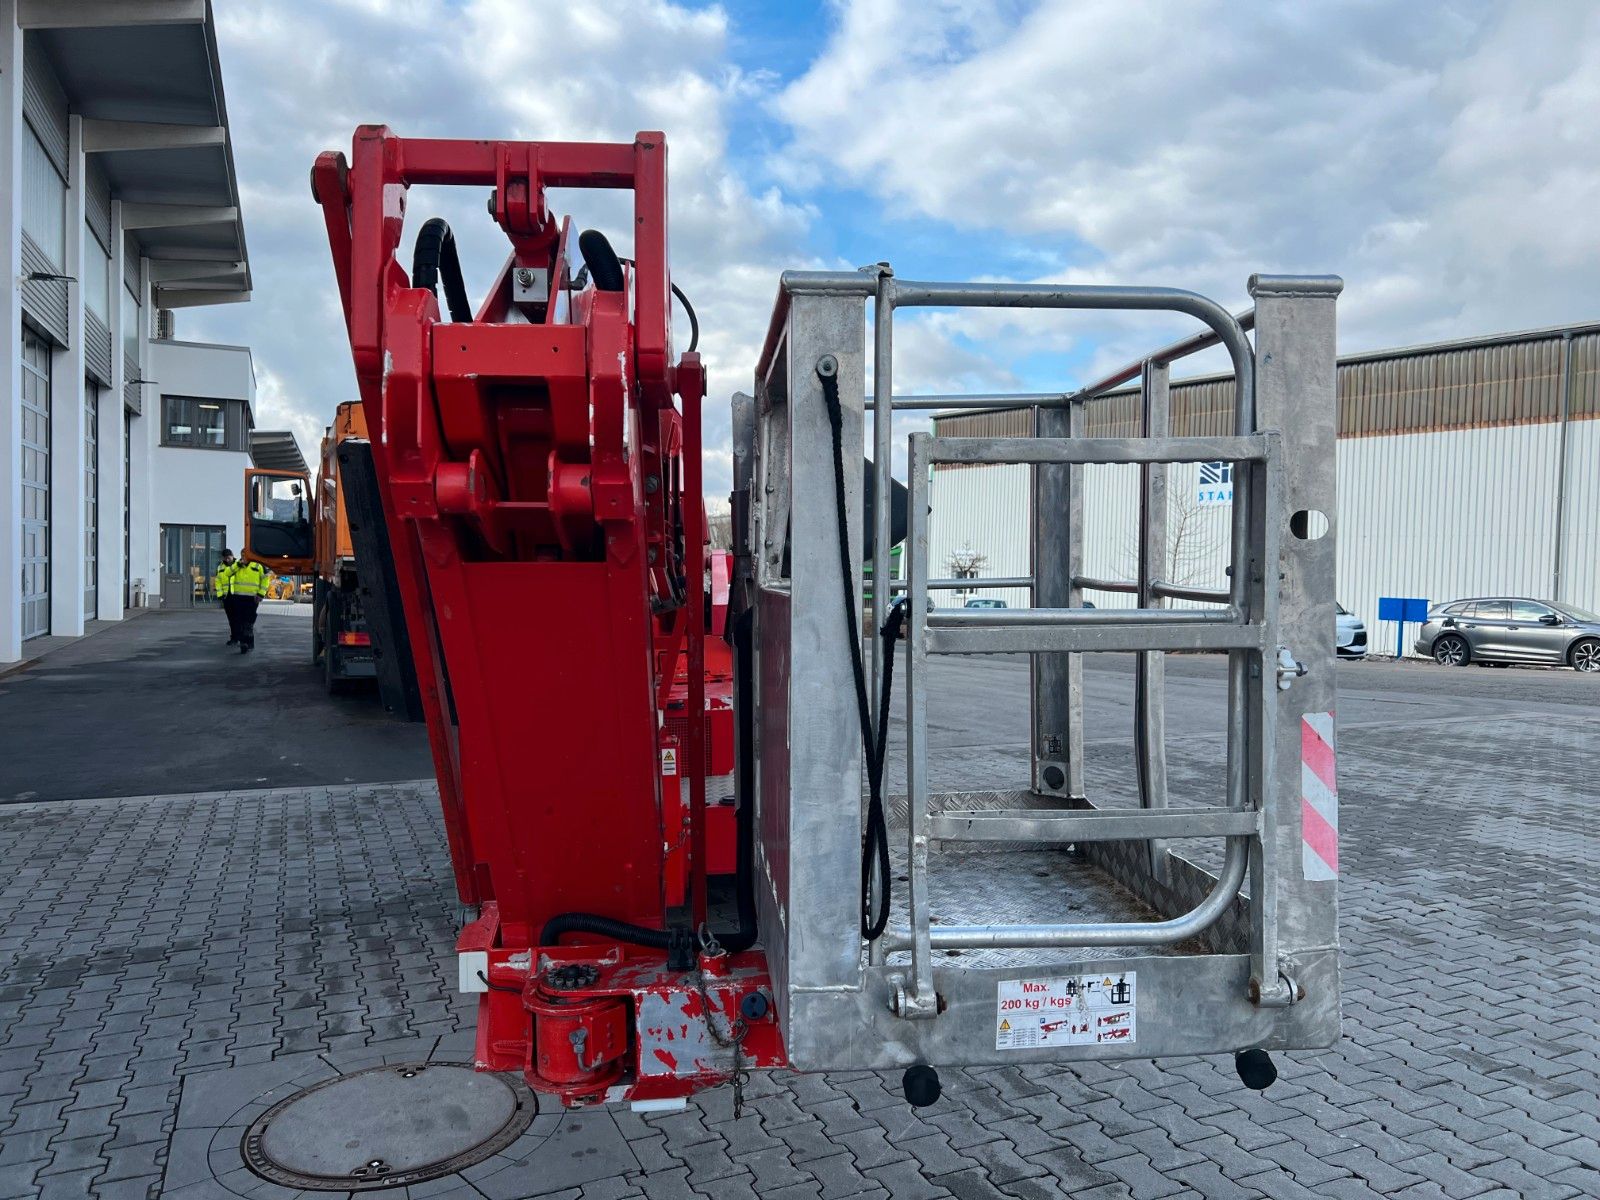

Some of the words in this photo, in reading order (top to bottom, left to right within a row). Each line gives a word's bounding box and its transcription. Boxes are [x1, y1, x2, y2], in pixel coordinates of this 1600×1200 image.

[1023, 982, 1050, 993] Max.
[1001, 1000, 1021, 1010] 200
[1025, 998, 1039, 1009] kg
[1050, 996, 1072, 1008] kgs
